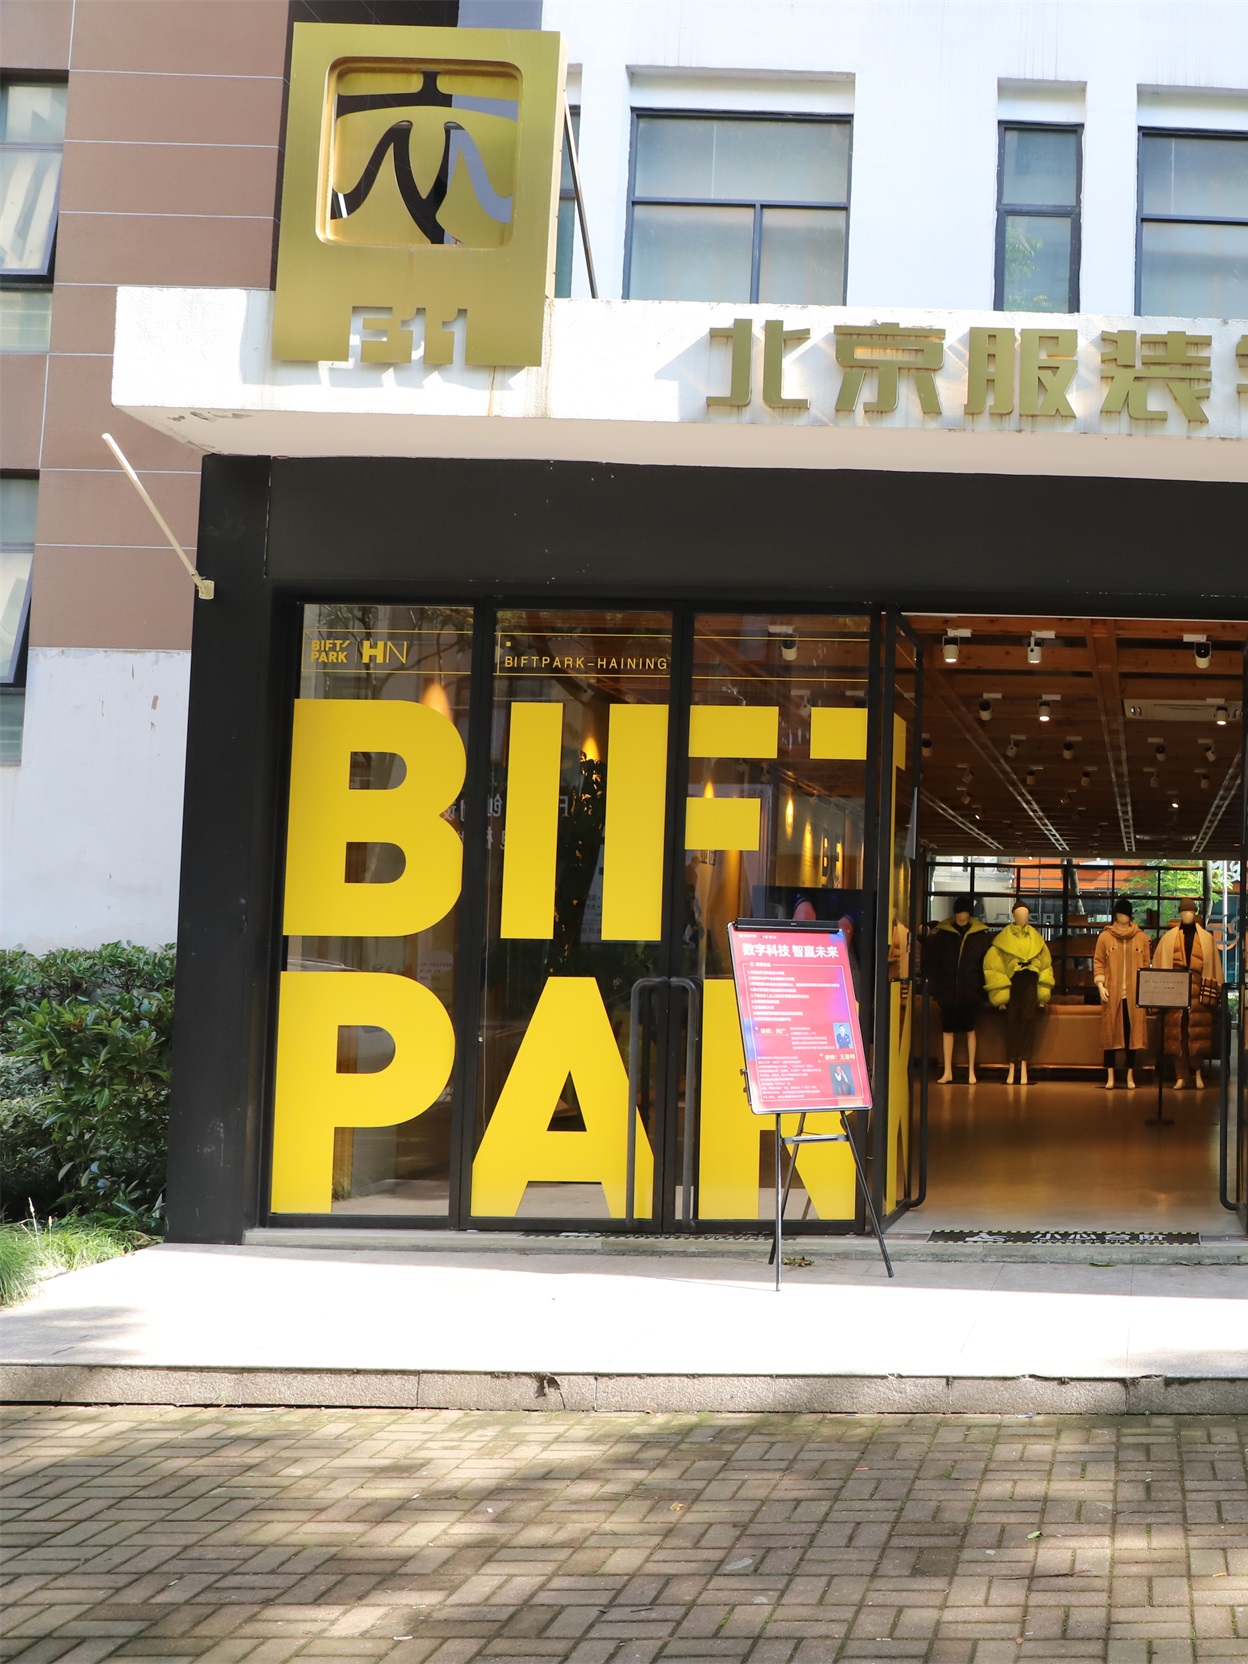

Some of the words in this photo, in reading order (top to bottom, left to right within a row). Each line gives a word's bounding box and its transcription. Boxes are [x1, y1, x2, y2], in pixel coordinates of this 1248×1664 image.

[311, 651, 347, 663] PARK
[362, 640, 408, 664] HN
[743, 943, 790, 957] 数字科技
[792, 944, 839, 958] 智赢未来
